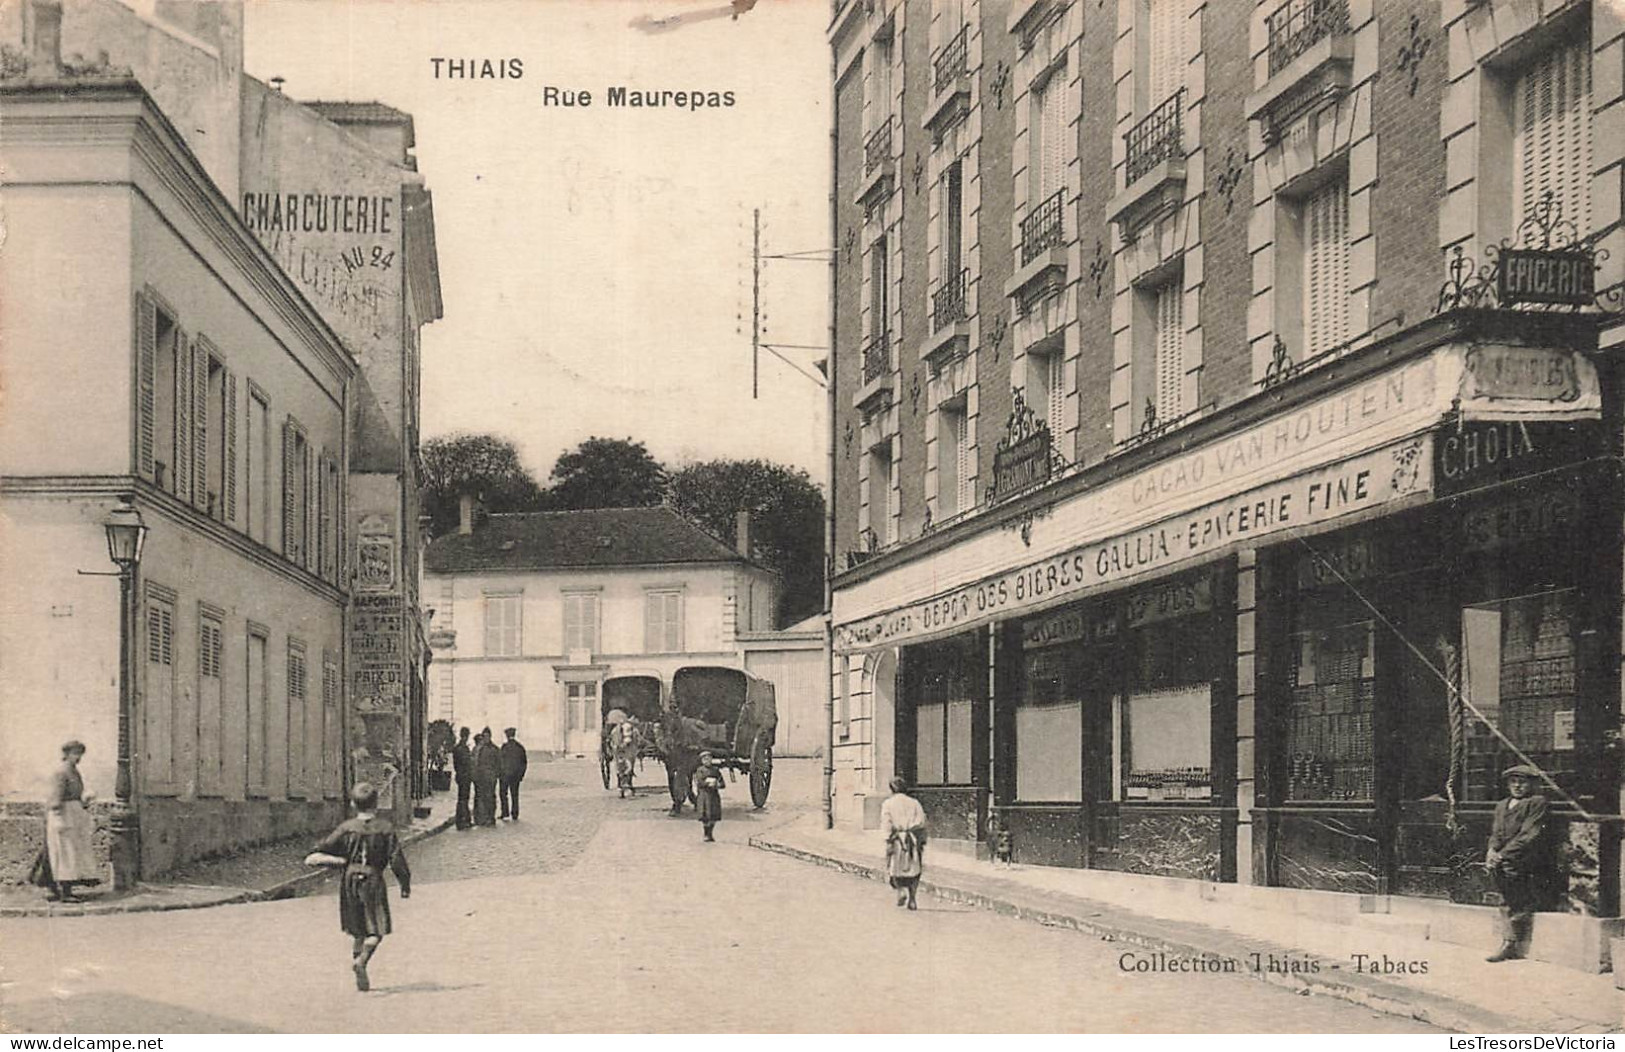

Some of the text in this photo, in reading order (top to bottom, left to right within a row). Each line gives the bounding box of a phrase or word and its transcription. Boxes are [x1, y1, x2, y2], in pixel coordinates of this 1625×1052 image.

[244, 193, 393, 233] CHARCUTERIE
[341, 246, 395, 273] AU 24
[1506, 256, 1588, 296] EPICERIE
[1132, 372, 1406, 505] CACAO VAN HOUTEN
[976, 580, 1008, 612] DES
[1096, 529, 1170, 577] GALLIA
[1188, 494, 1292, 550] EPICERIE
[1308, 469, 1372, 515] FINE
